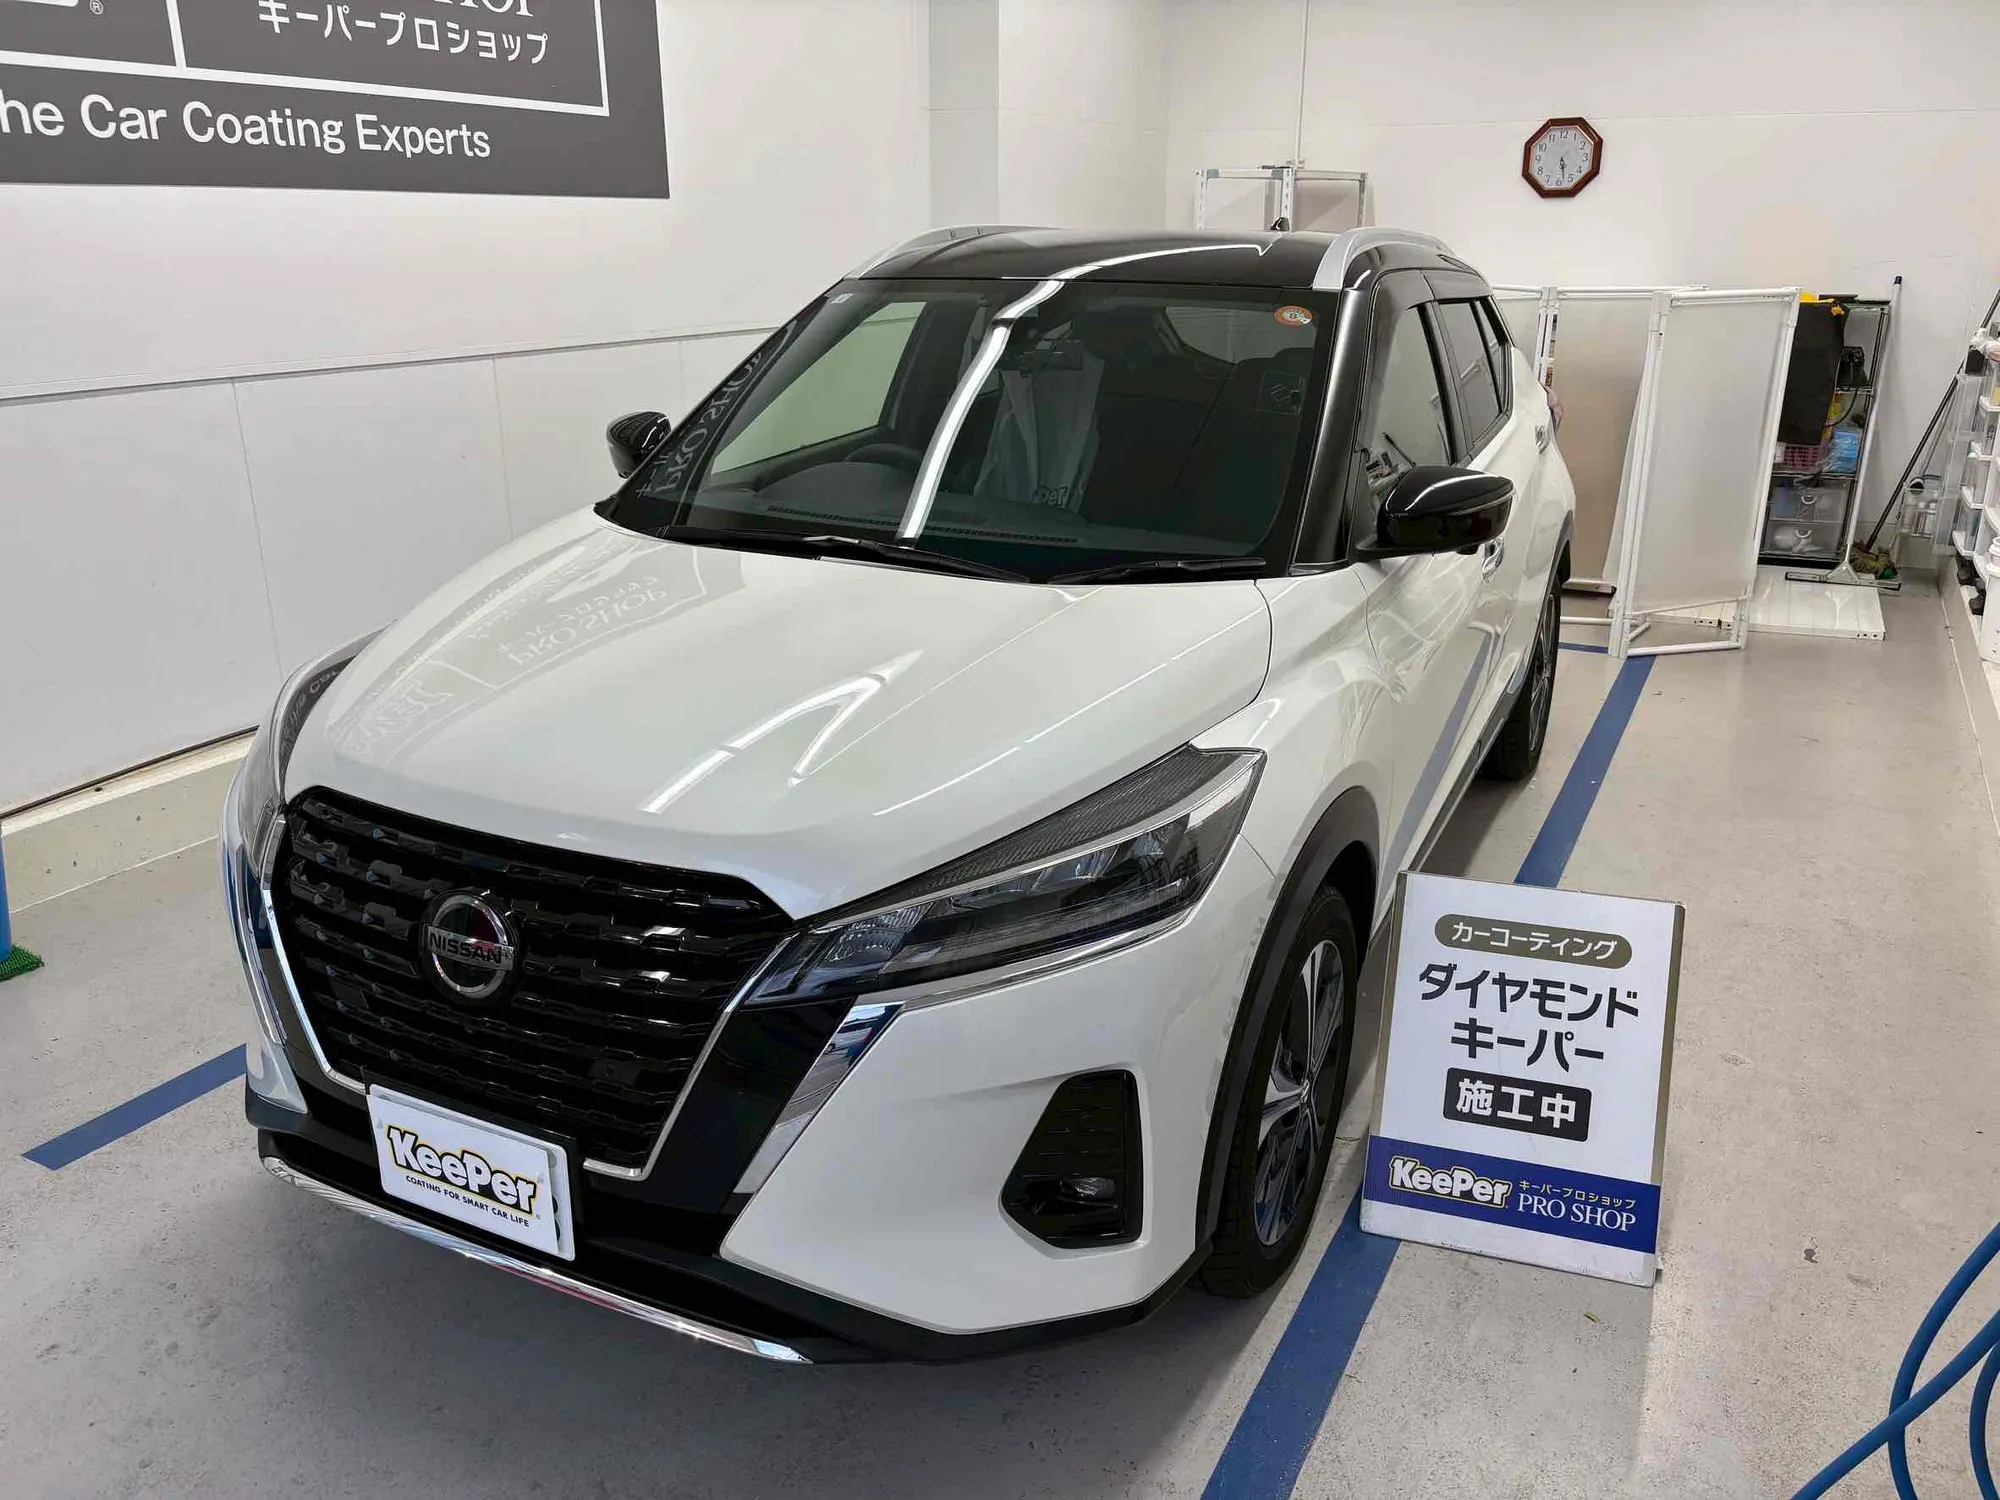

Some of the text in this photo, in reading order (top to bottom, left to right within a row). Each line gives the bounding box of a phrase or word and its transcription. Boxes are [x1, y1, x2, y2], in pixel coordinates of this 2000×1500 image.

[258, 0, 548, 64] キーパープロショップ
[81, 93, 167, 141] Car
[182, 100, 346, 154] Coating
[355, 113, 491, 158] Experts
[429, 931, 502, 965] NISSAN
[1451, 921, 1618, 960] カーコーティング
[1418, 962, 1640, 1029] ダイヤモンド
[1450, 1017, 1605, 1073] キーパー
[1455, 1077, 1577, 1129] 施工中
[387, 1125, 538, 1216] KeePer
[1389, 1155, 1512, 1209] KeePer
[1519, 1180, 1637, 1209] キーパープロショップ
[406, 1175, 530, 1228] COATING FOR SMART CAR LIFE
[1517, 1192, 1637, 1232] PRO SHOP
